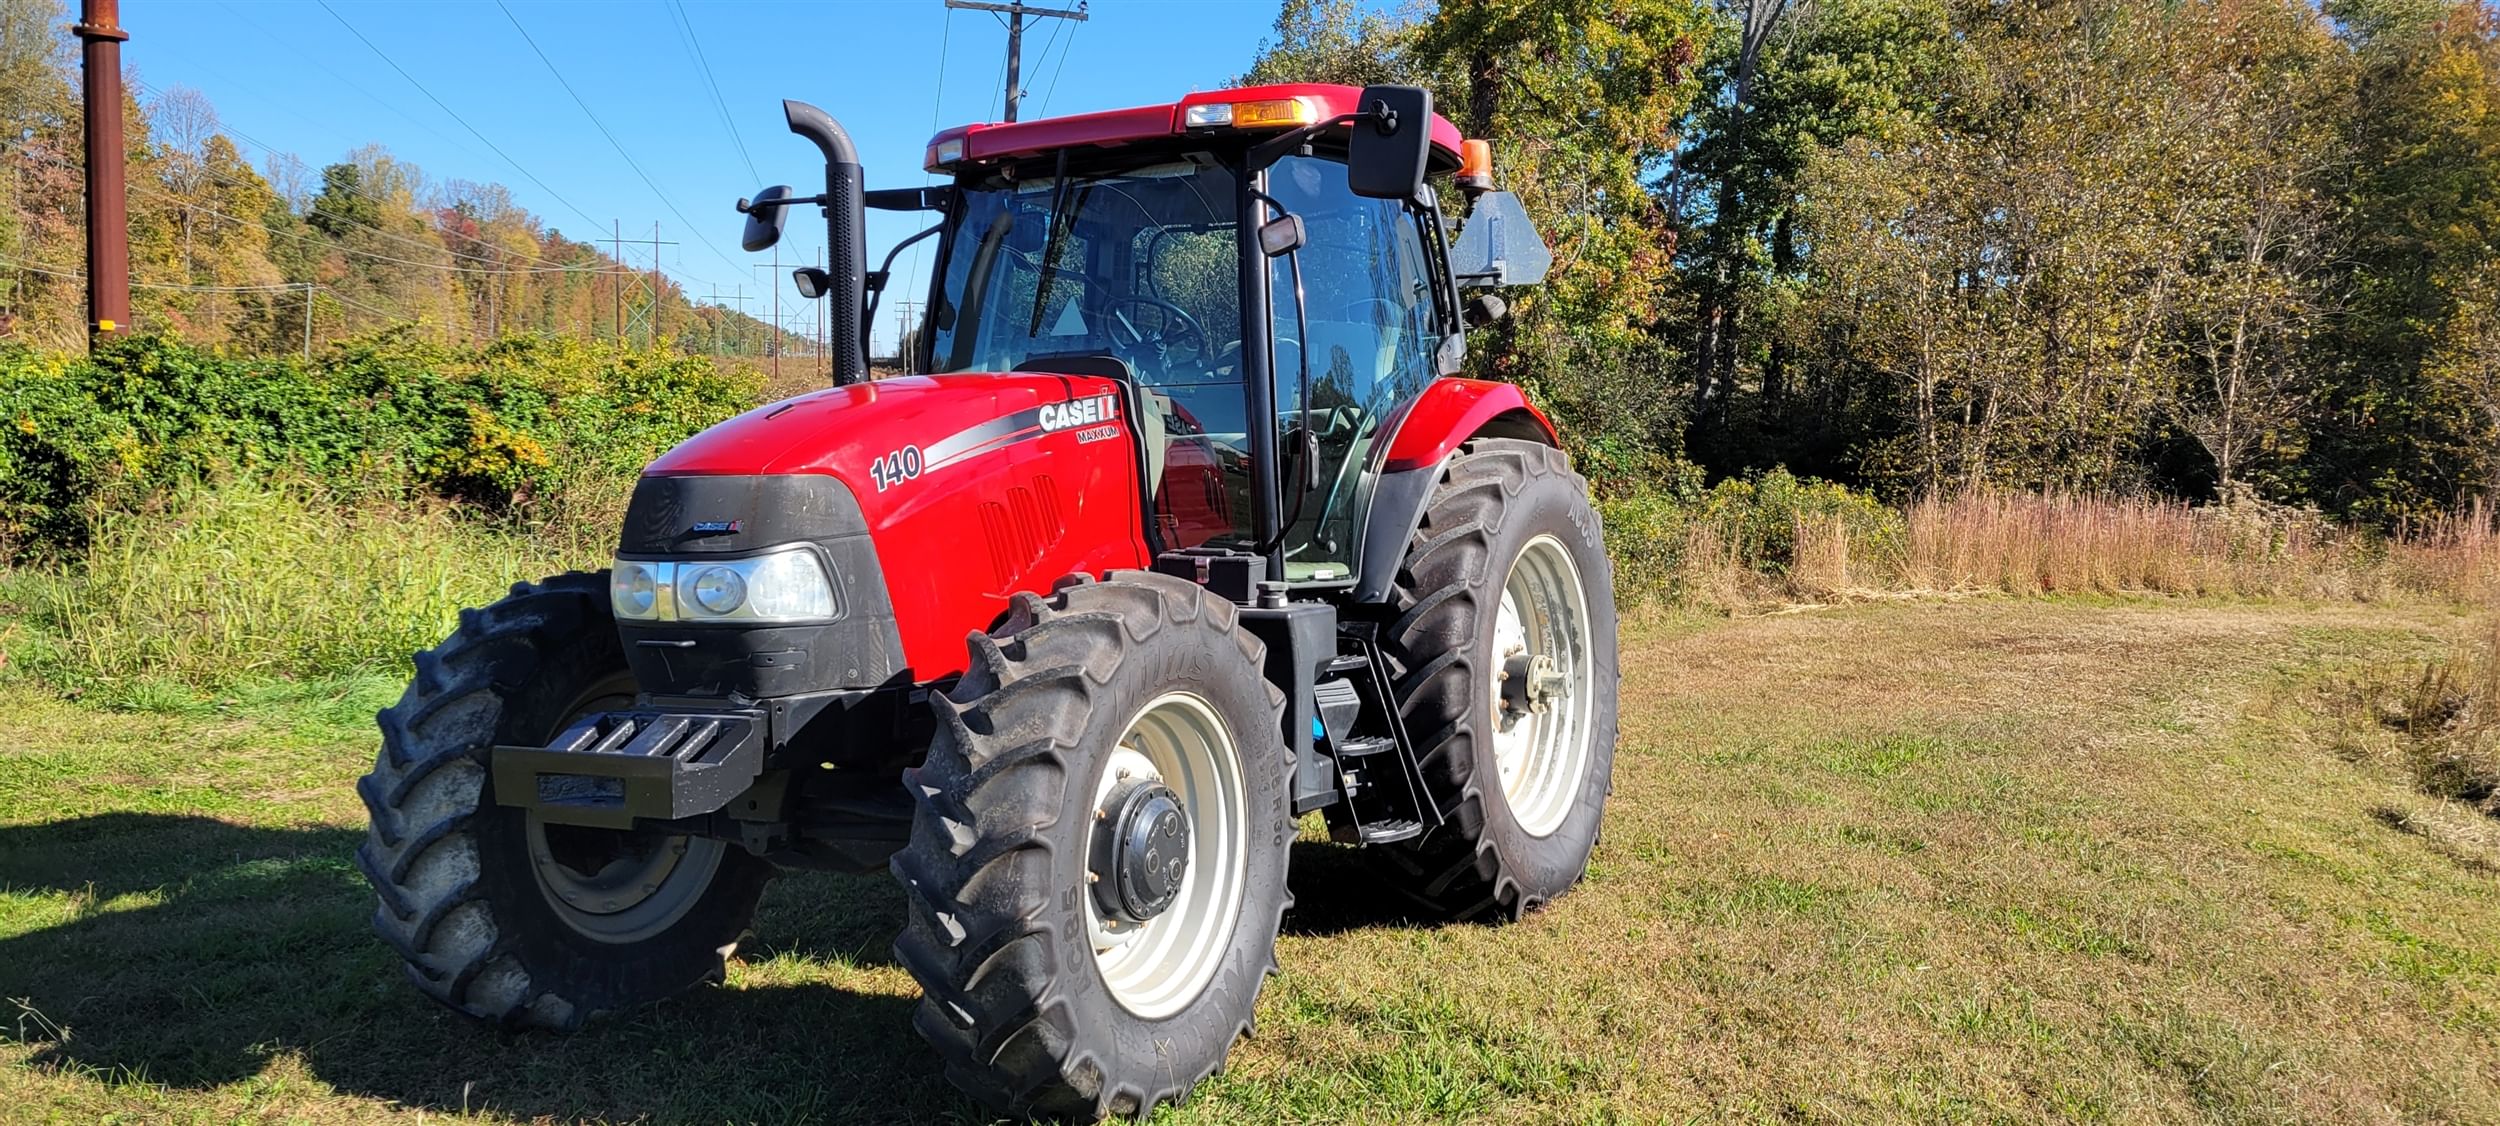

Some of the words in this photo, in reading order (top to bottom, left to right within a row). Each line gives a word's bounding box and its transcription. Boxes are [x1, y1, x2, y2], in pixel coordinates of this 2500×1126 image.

[1039, 400, 1098, 432] CASE
[869, 445, 922, 493] 140
[693, 521, 729, 532] CASE
[1273, 819, 1283, 848] 30
